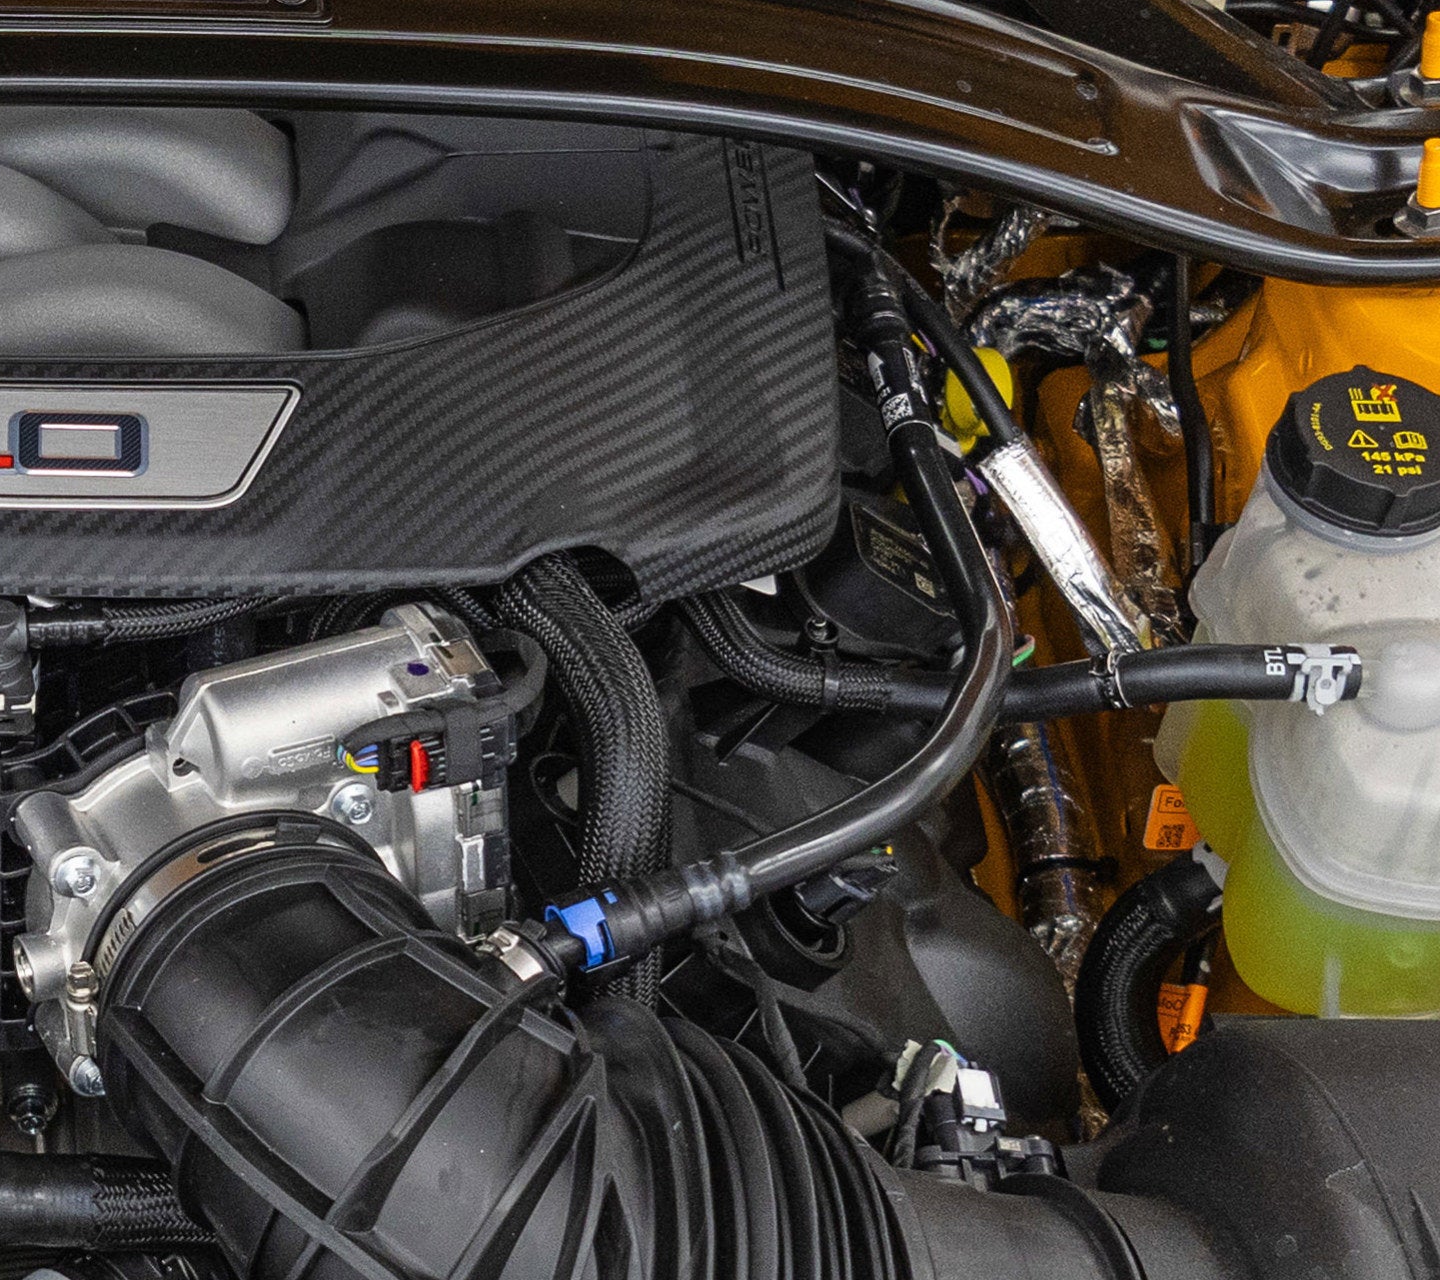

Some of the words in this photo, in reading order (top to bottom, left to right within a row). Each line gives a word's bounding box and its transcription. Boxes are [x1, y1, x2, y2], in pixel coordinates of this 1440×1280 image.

[1361, 451, 1392, 463] 145
[1393, 451, 1426, 463] kPa
[1372, 464, 1393, 476] 21
[1396, 464, 1422, 477] psi
[1264, 646, 1286, 677] BTL
[1165, 796, 1186, 808] Fo
